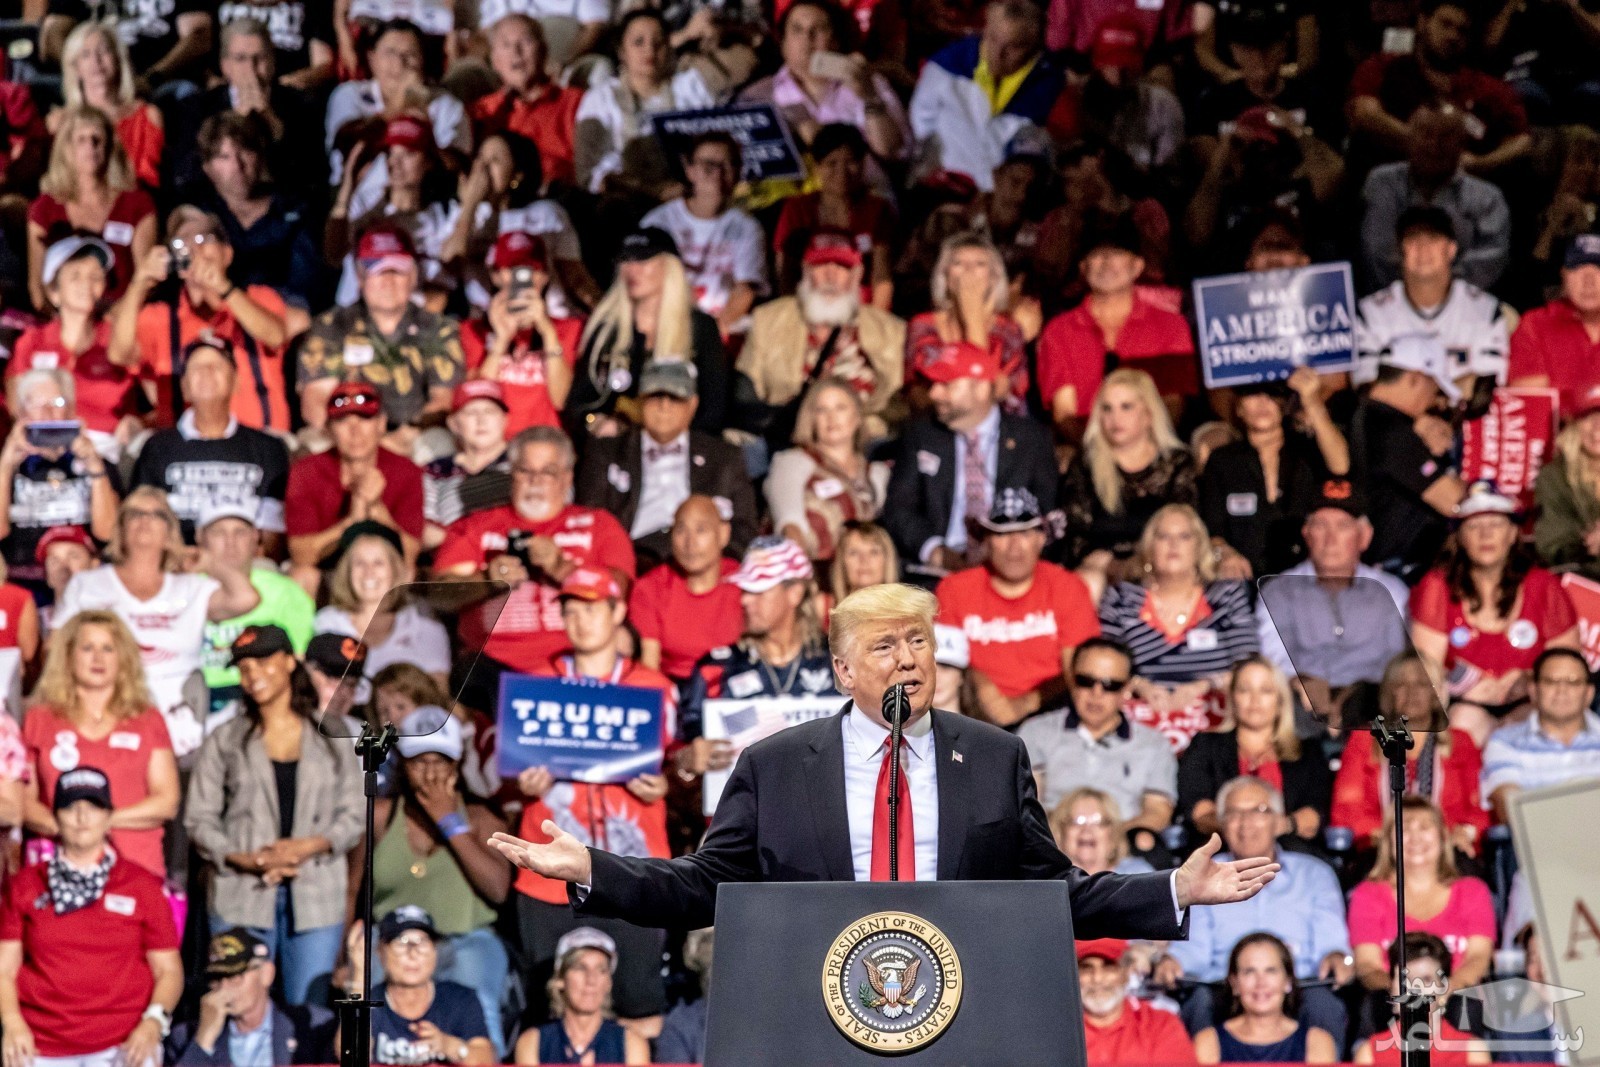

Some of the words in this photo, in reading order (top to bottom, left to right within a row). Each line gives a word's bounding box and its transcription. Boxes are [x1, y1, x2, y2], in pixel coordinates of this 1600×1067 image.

[1207, 302, 1351, 344] AMERICA
[1209, 338, 1291, 367] STRONG
[511, 699, 652, 728] TRUMP
[522, 720, 638, 742] PENCE
[893, 918, 907, 927] OF
[909, 920, 927, 935] THE
[827, 916, 890, 979] PRESIDENT
[928, 933, 958, 990] UNITED
[829, 982, 841, 1003] THE
[834, 1003, 846, 1016] OF
[904, 1001, 952, 1044] STATES
[844, 1014, 880, 1044] SEAL
